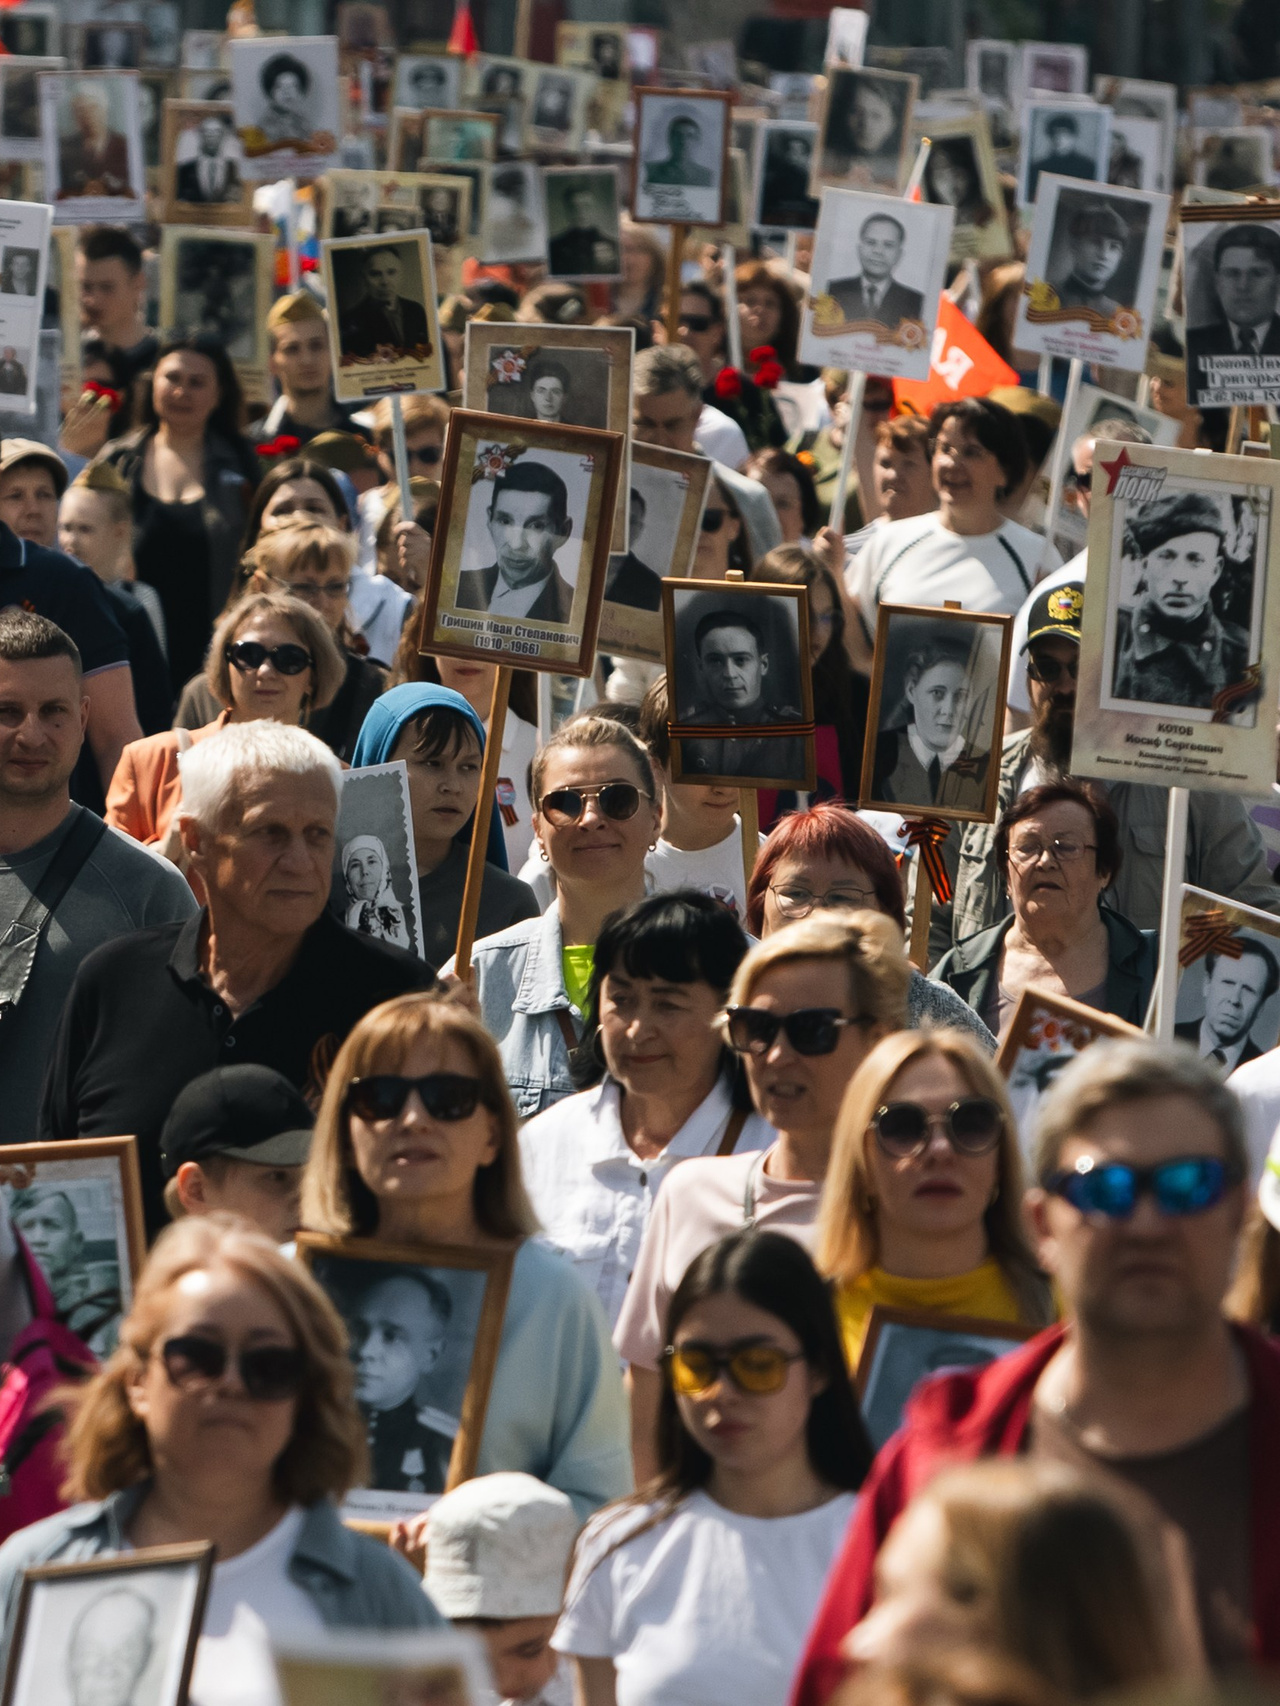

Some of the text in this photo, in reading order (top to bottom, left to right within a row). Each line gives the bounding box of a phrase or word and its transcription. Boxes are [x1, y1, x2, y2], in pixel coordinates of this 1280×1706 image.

[1112, 476, 1162, 501] ПОЛК
[441, 614, 579, 645] Гришин Иван Степанович
[1158, 723, 1193, 736] КОТОВ
[1125, 733, 1223, 754] Иосиф Сергеевич
